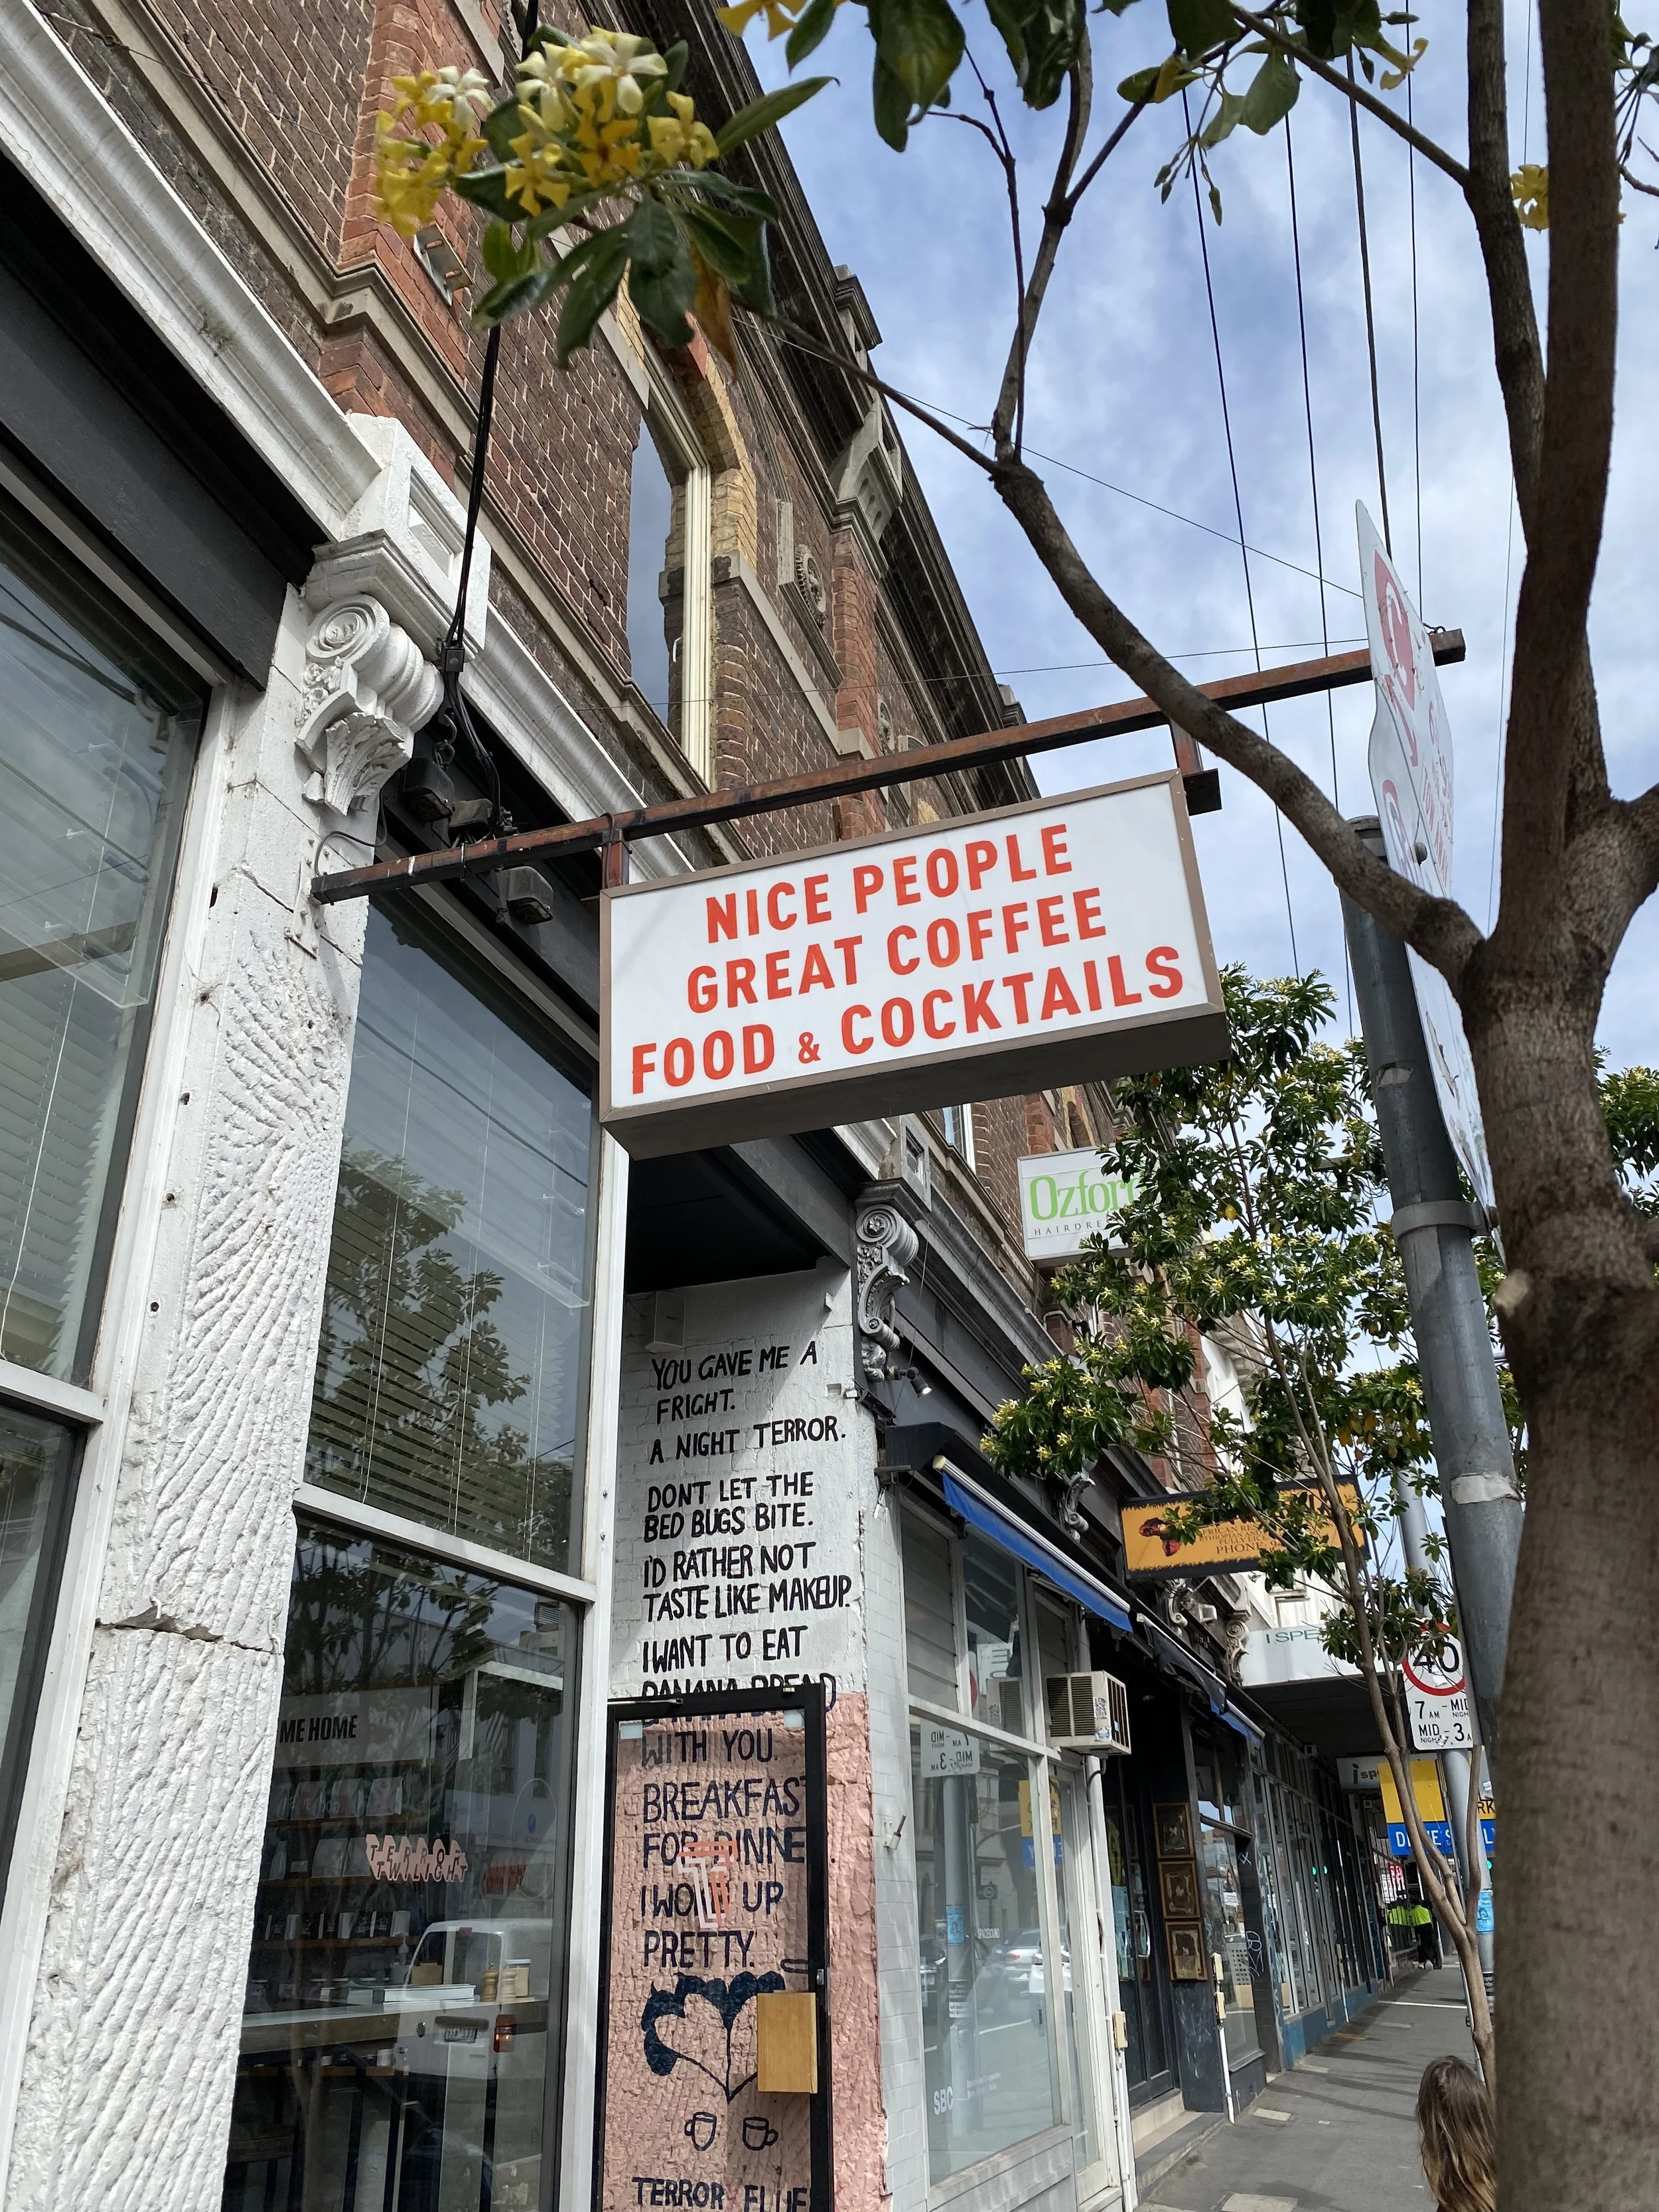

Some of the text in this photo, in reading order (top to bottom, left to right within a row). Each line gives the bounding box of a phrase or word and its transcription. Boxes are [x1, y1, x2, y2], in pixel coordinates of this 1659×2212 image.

[706, 824, 1072, 943] NICE PEOPLE
[687, 887, 1106, 1013] GREAT COFFEE
[632, 946, 1183, 1094] FOOD & COCKTAILS
[652, 1341, 818, 1390] YOU GAVE ME A
[656, 1388, 735, 1424] FRIGHT.
[650, 1416, 846, 1465] A NIGHT TERROR.
[648, 1471, 814, 1512] DONT LET THE
[644, 1503, 814, 1543] BED BUGS BITE.
[1200, 1526, 1237, 1536] FRICAN
[643, 1542, 816, 1588] I'D RATHER NOT
[643, 1575, 851, 1623] TASTE LIKE MAKEUP.
[642, 1625, 808, 1673] I WANT TO EAT
[1413, 1642, 1459, 1673] 40
[279, 1715, 358, 1743] ME HOME
[1415, 1701, 1425, 1719] 7
[642, 1728, 778, 1766] WITH YOU.
[1419, 1724, 1439, 1736] MID
[1453, 1723, 1465, 1741] 3
[371, 1845, 461, 1865] TERROR
[643, 1830, 697, 1868] FOR
[377, 1862, 467, 1881] TWILIGHT
[641, 1885, 646, 1917] I
[743, 1881, 784, 1915] UP
[644, 1930, 755, 1968] PRETTY.
[934, 2086, 953, 2116] SBC
[632, 2177, 725, 2210] TERROR
